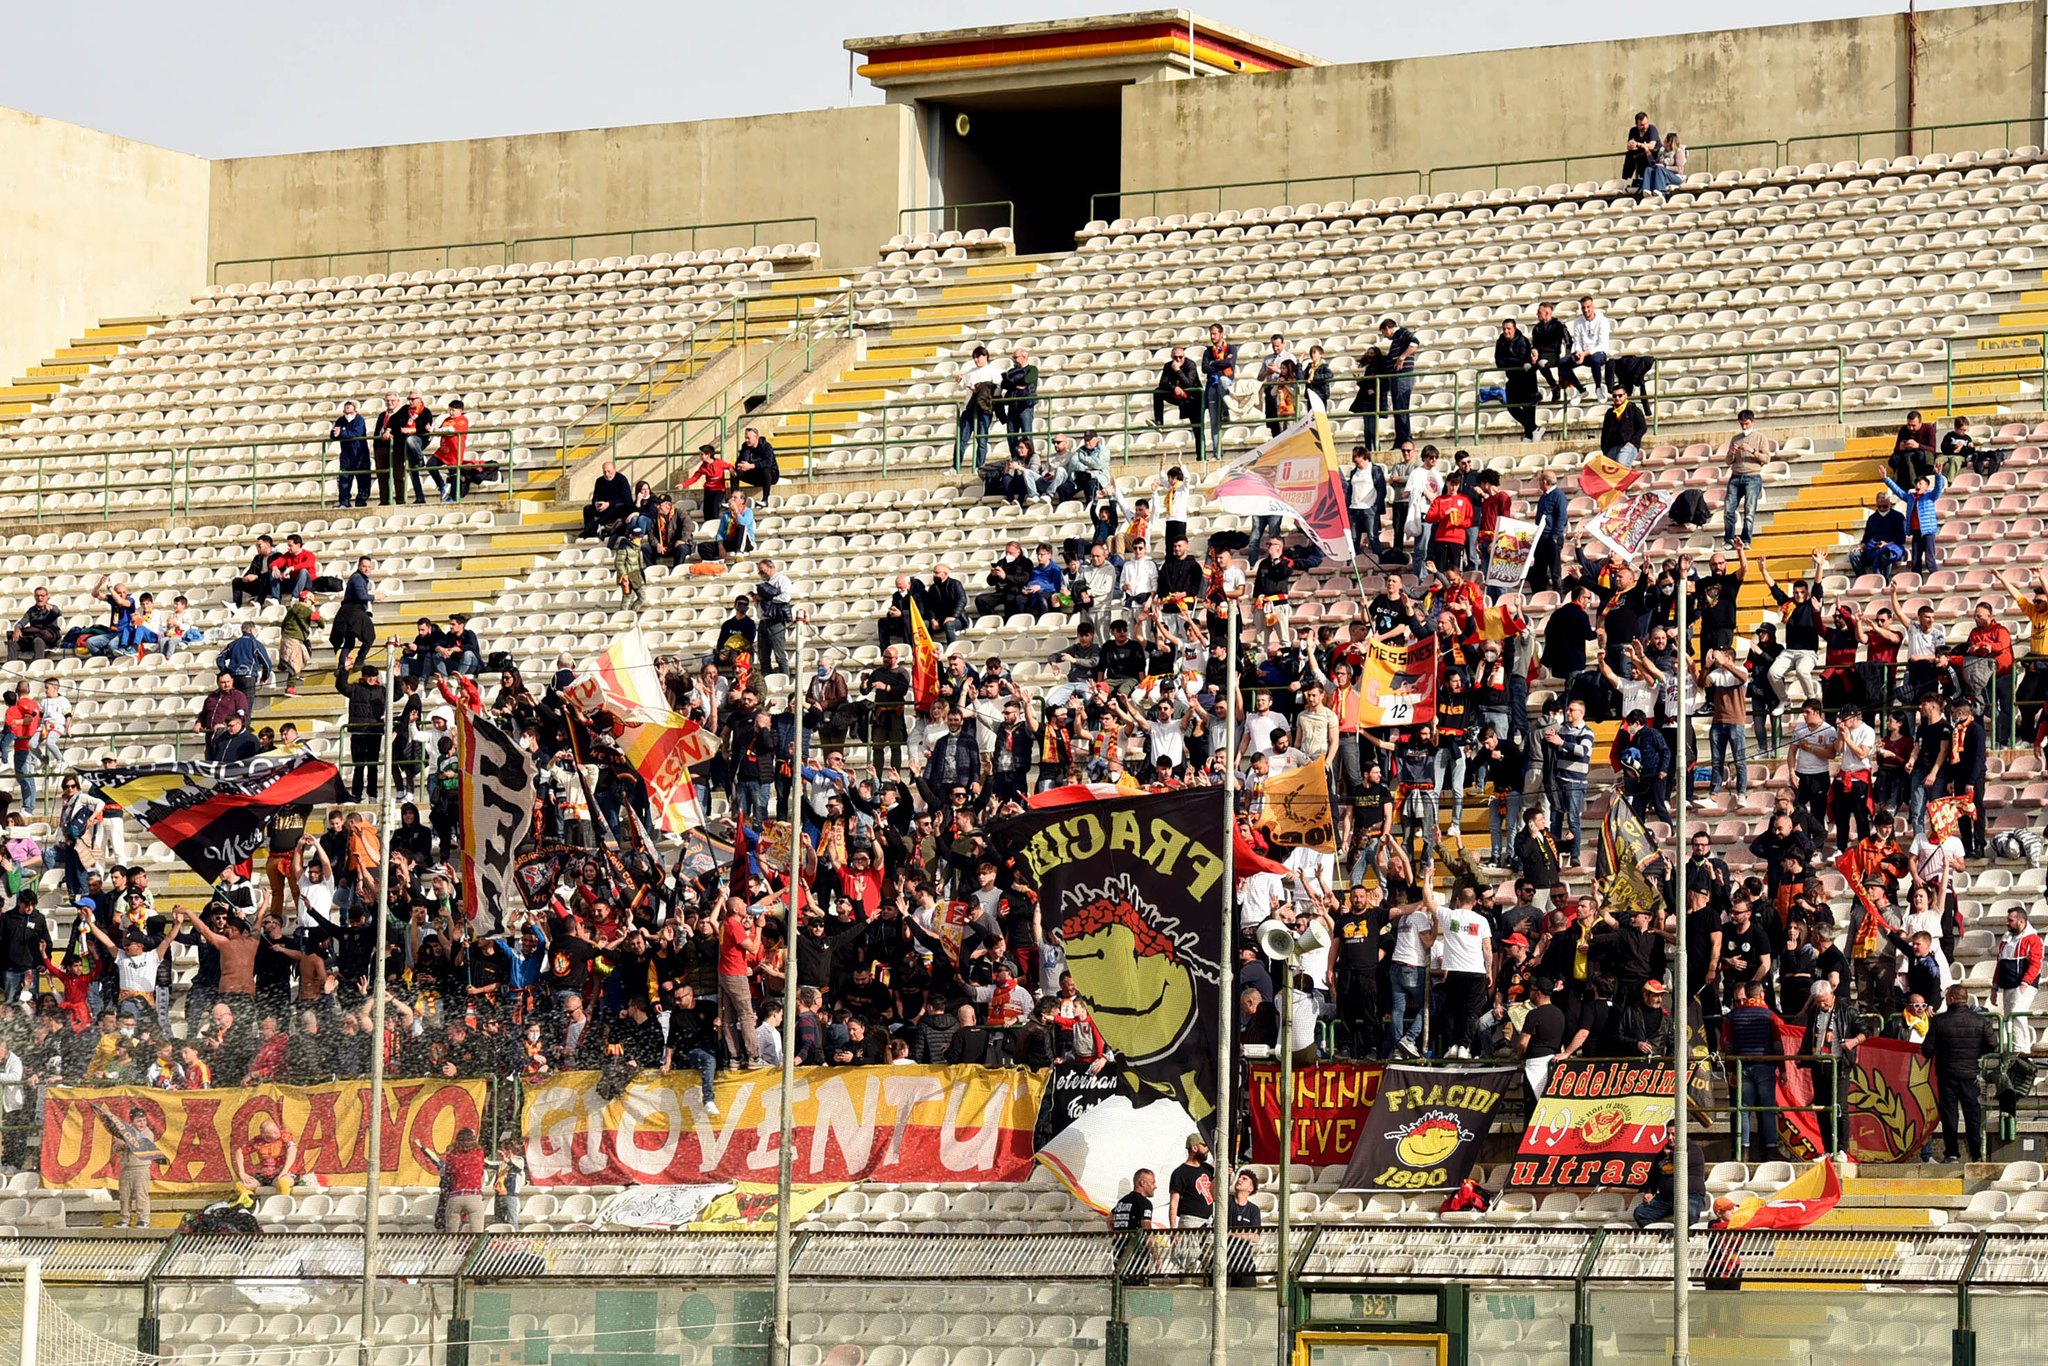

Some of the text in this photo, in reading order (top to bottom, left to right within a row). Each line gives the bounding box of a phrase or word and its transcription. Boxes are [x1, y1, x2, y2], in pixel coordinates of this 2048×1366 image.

[1546, 1062, 1698, 1097] fedelissimi
[1385, 1084, 1501, 1113] FRACIDI
[40, 1085, 480, 1184] URAGANO
[1373, 1167, 1448, 1189] 1990
[1511, 1155, 1652, 1186] ultras
